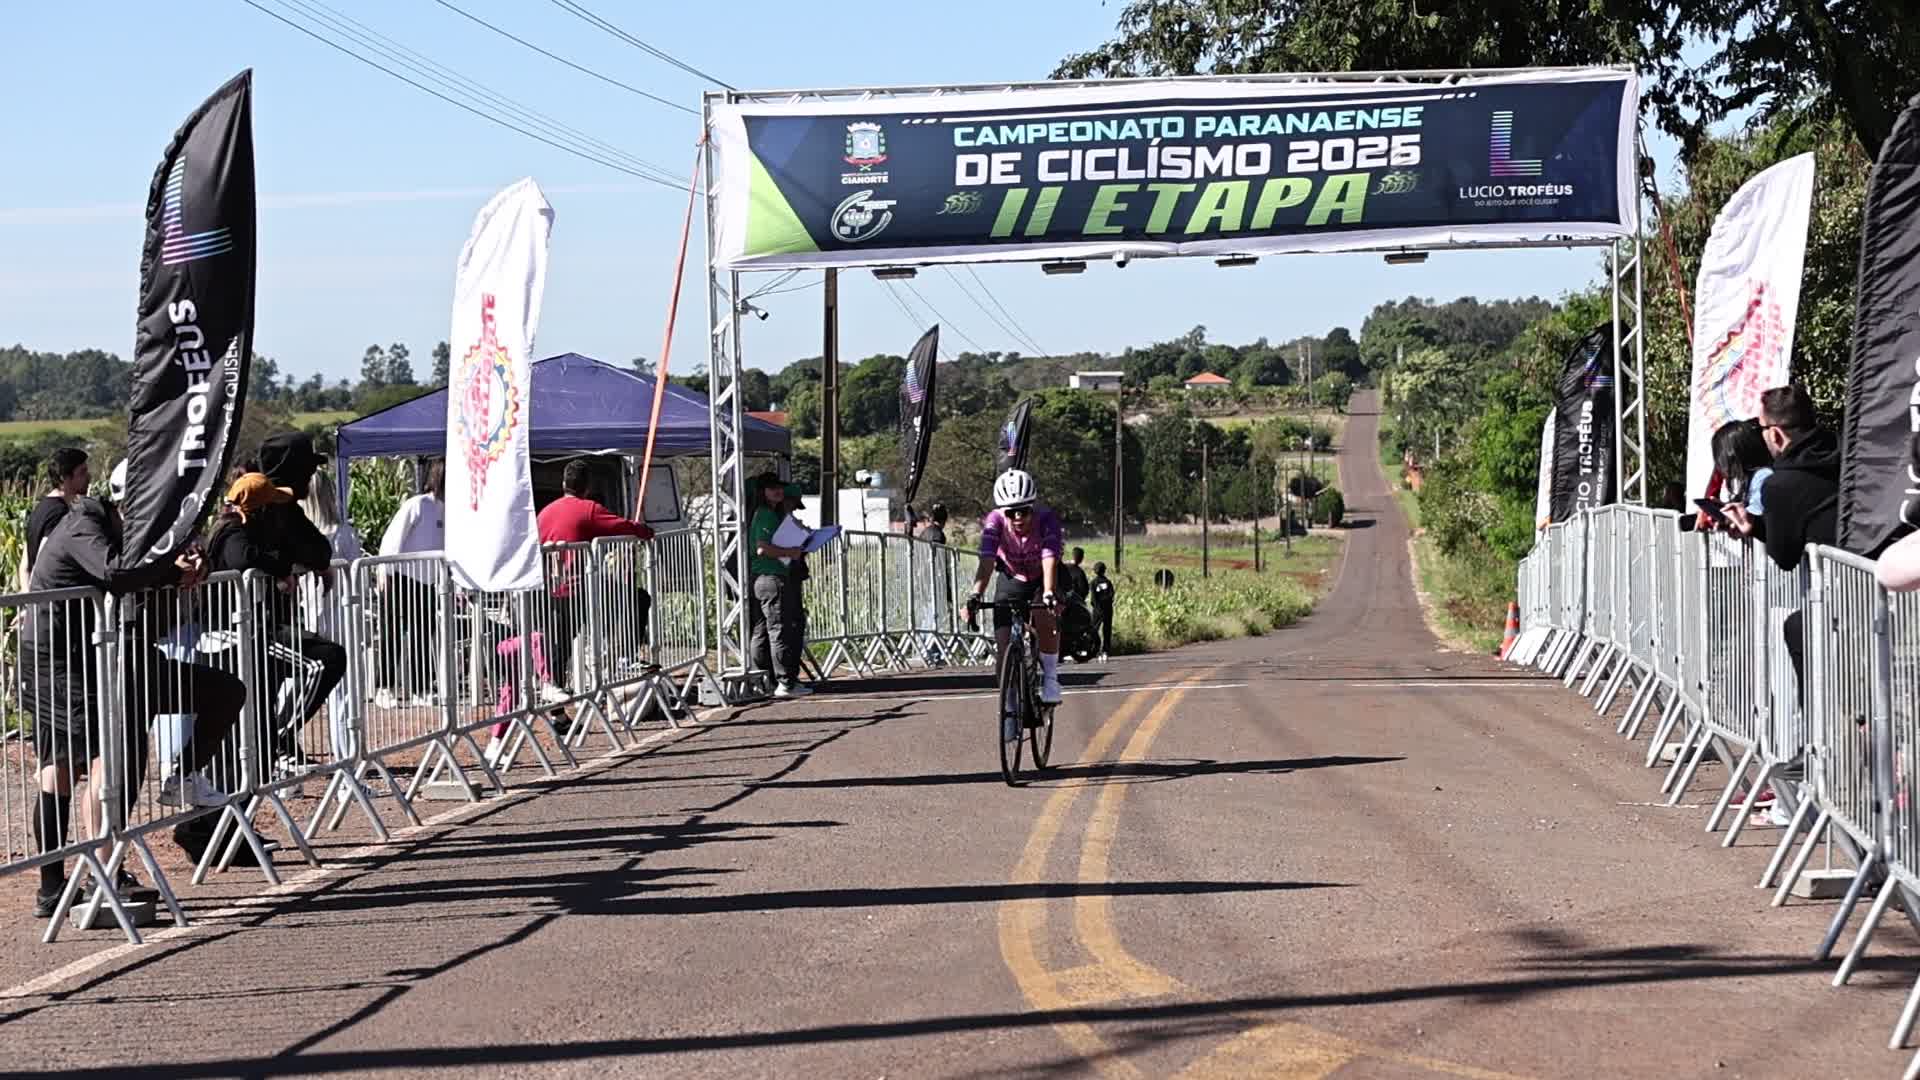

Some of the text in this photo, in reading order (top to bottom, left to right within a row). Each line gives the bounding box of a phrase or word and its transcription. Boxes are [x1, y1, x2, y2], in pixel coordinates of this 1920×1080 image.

[954, 106, 1424, 147] CAMPEONATO PARANAENSE
[841, 175, 889, 184] CIANORTE
[955, 152, 1022, 186] DE
[1037, 137, 1272, 183] CICLÍSMO
[990, 172, 1371, 238] II ETAPA
[1459, 182, 1574, 199] LUCIO TROFÉUS
[168, 299, 212, 477] TROFÉUS
[1576, 400, 1593, 476] TROFÉUS
